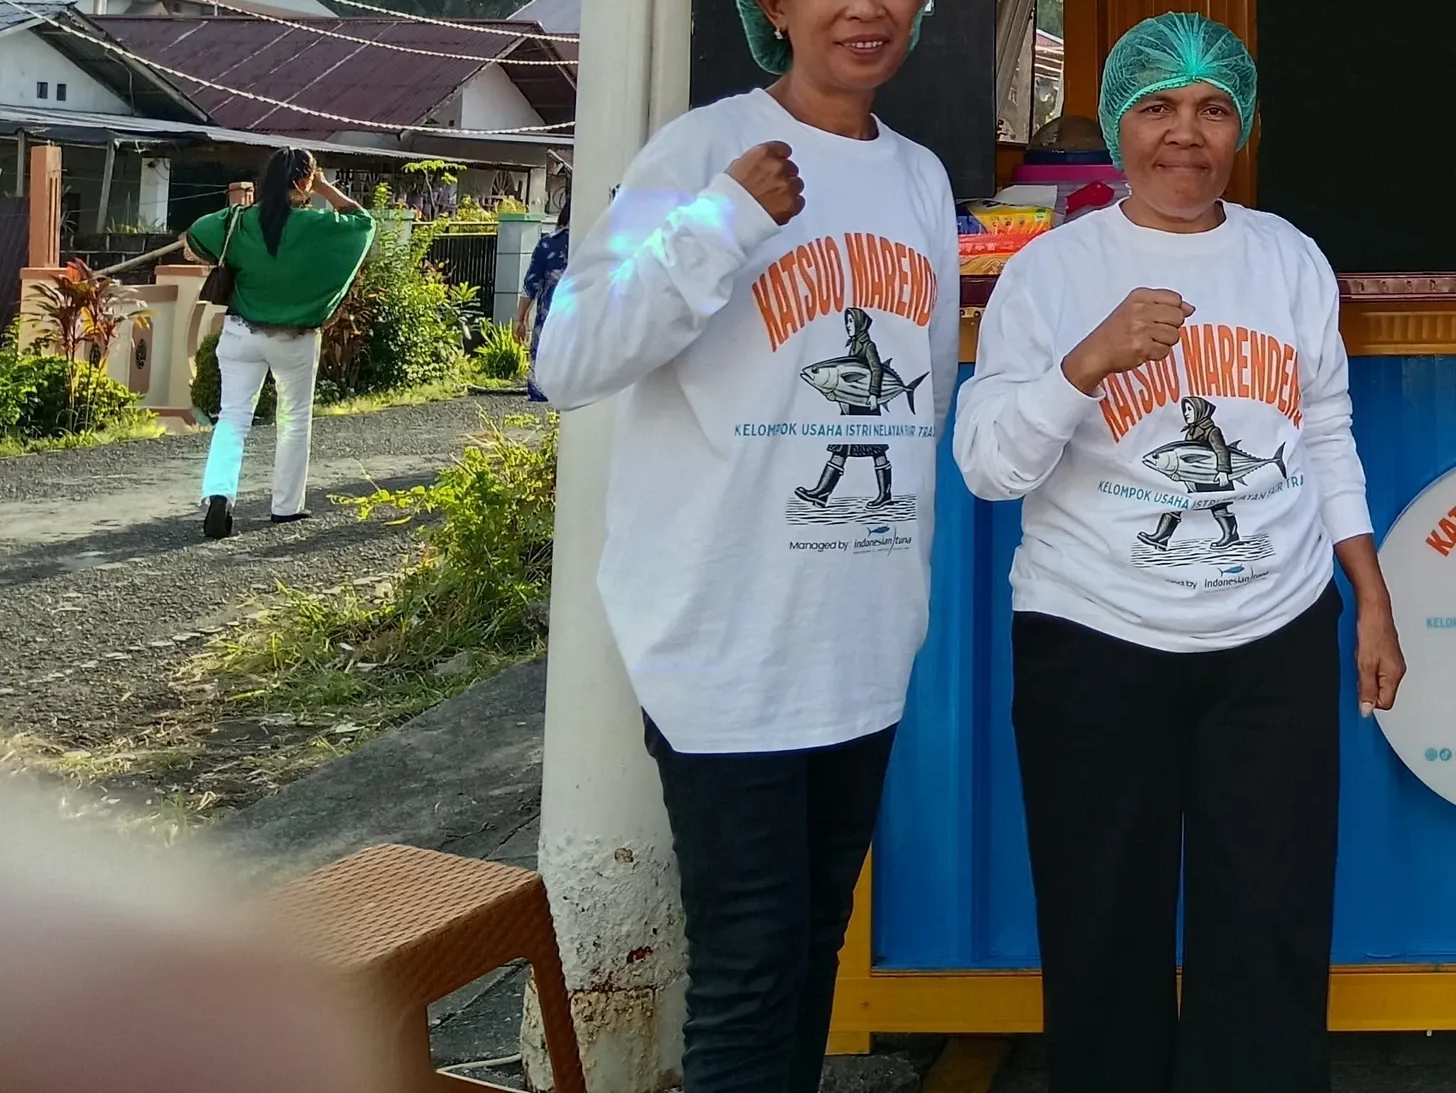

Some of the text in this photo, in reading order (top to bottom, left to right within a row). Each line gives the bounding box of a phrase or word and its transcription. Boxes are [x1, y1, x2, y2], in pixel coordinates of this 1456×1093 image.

[752, 235, 845, 352] KATSUO
[734, 423, 797, 437] KELOMPOK
[802, 423, 842, 436] USAHA
[846, 423, 872, 436] ISTRI
[1098, 480, 1152, 501] KELOMPOK
[1154, 491, 1190, 510] USAHA
[789, 541, 836, 552] Managed
[853, 538, 892, 549] indonesian
[895, 536, 912, 545] tuna
